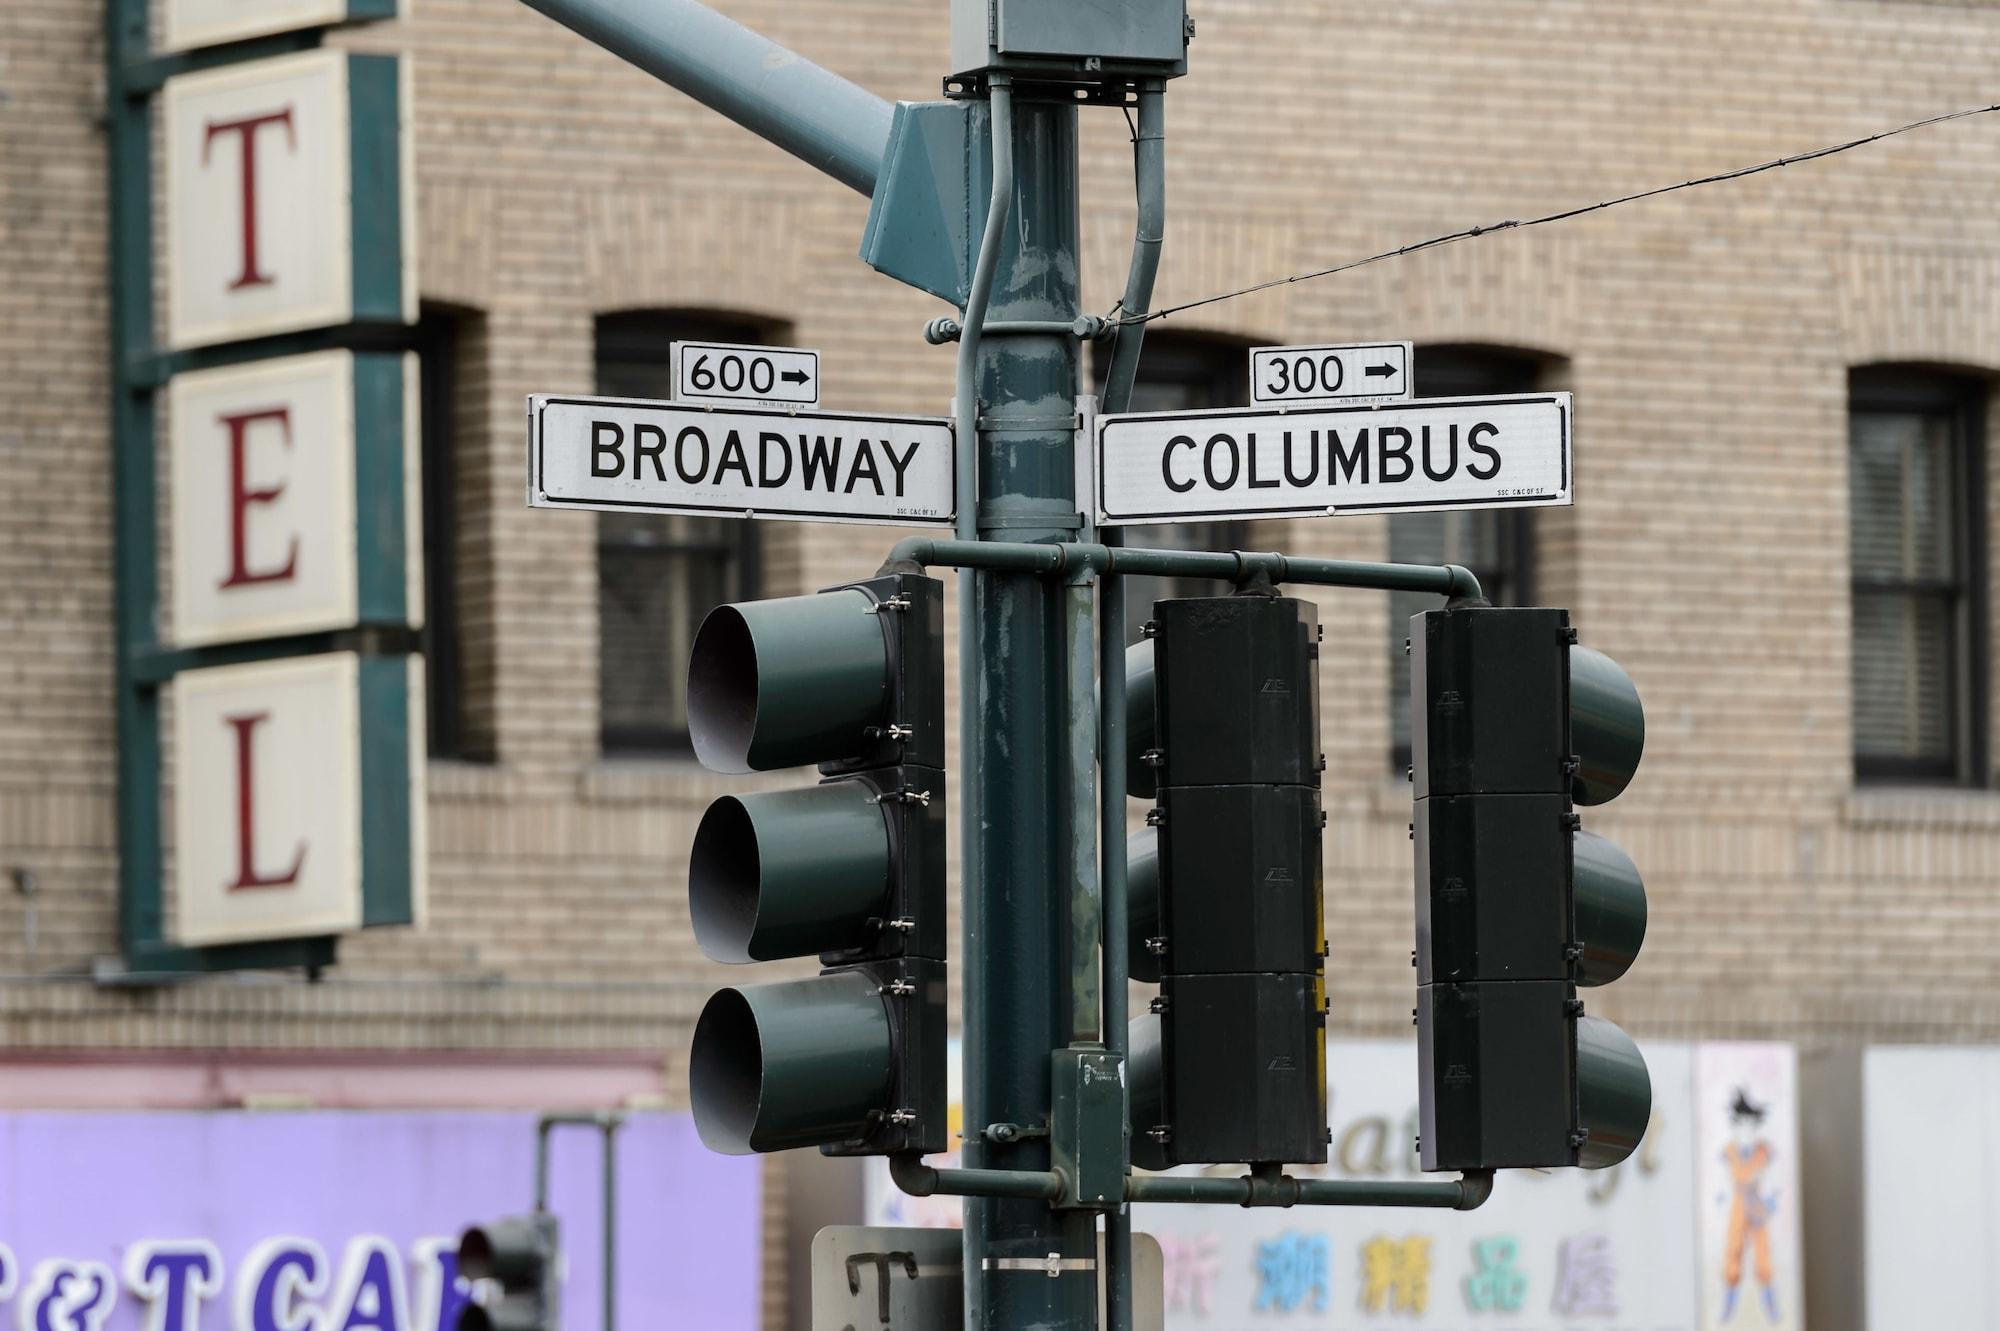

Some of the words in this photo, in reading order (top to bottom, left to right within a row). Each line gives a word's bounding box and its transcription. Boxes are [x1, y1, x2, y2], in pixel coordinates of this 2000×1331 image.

[690, 353, 775, 394] 600
[1266, 354, 1344, 395] 300
[590, 420, 920, 497] BROADWAY
[1161, 421, 1502, 493] COLUMBUS
